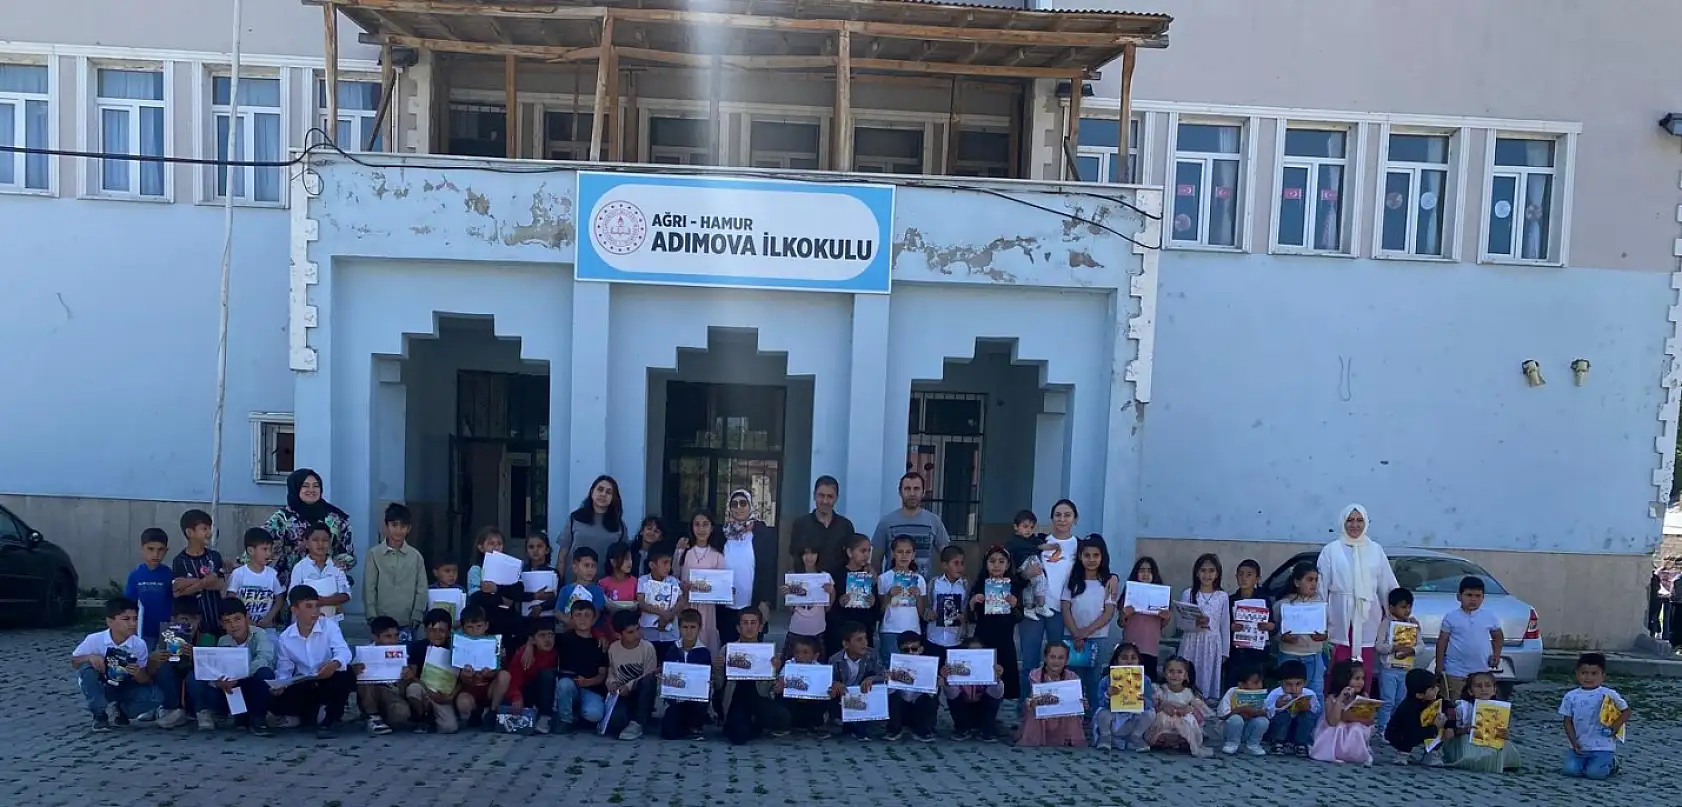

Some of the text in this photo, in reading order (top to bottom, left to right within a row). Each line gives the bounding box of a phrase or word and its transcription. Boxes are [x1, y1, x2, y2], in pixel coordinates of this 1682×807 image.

[651, 211, 687, 228] AĞRI
[700, 215, 753, 231] HAMUR
[651, 231, 872, 261] ADIMOVA İLKOKULU
[240, 587, 274, 601] NEVER
[246, 601, 268, 613] GIVE
